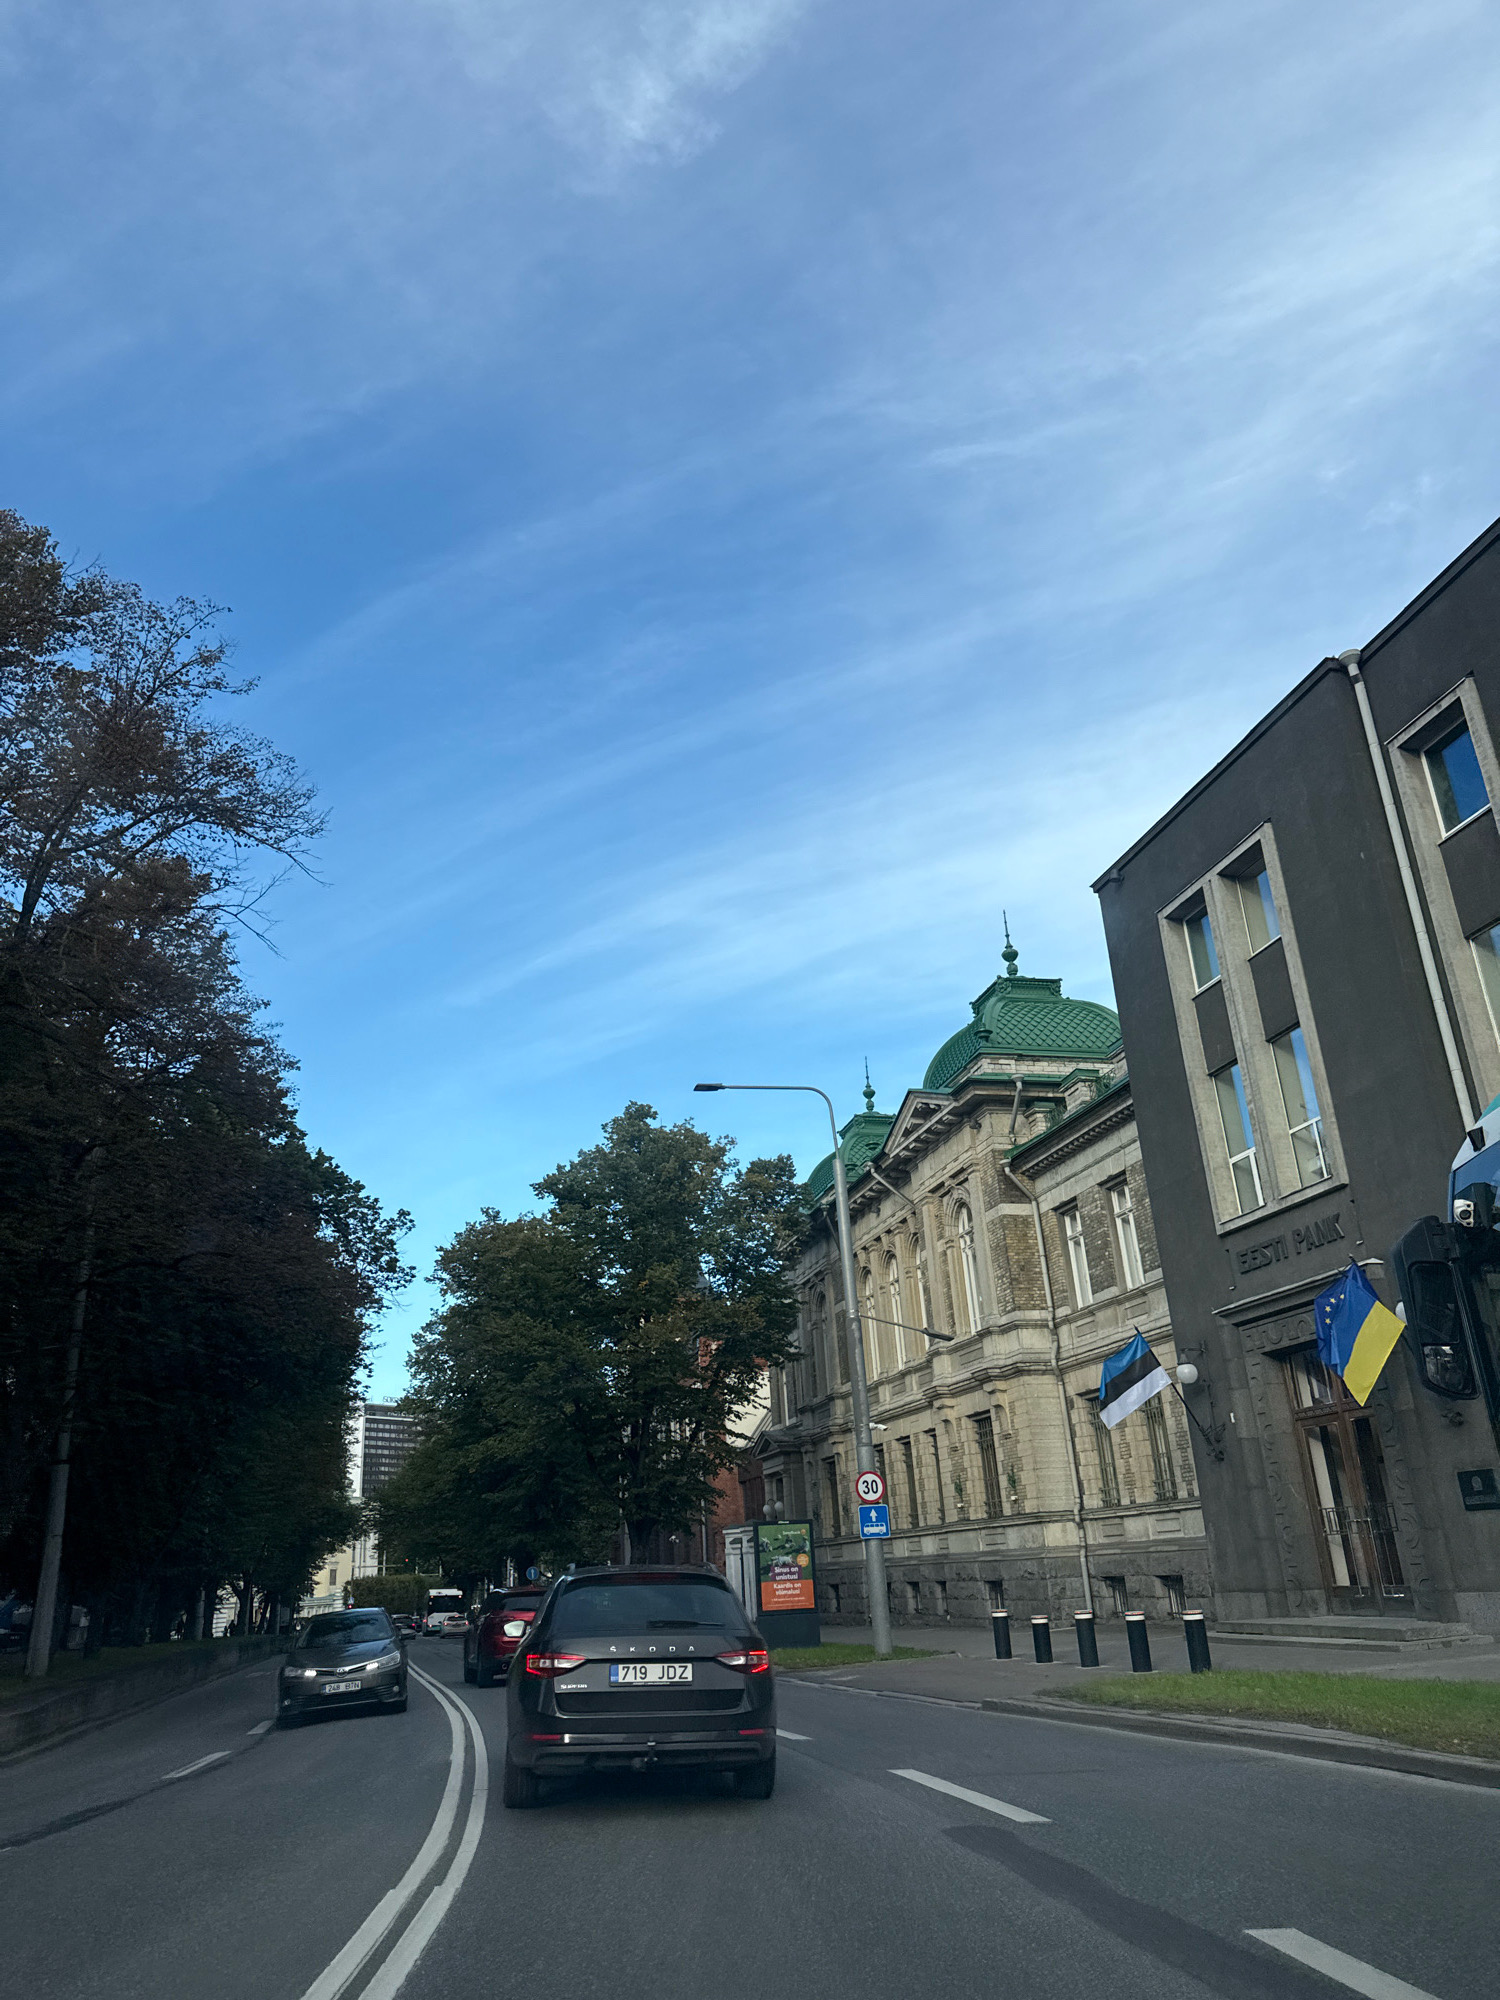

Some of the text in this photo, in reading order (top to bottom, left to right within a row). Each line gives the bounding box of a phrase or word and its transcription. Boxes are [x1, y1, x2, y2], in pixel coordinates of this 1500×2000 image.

[1237, 1213, 1345, 1275] EESTI PANK
[862, 1480, 878, 1494] 30
[621, 1665, 689, 1681] 719 JDZ
